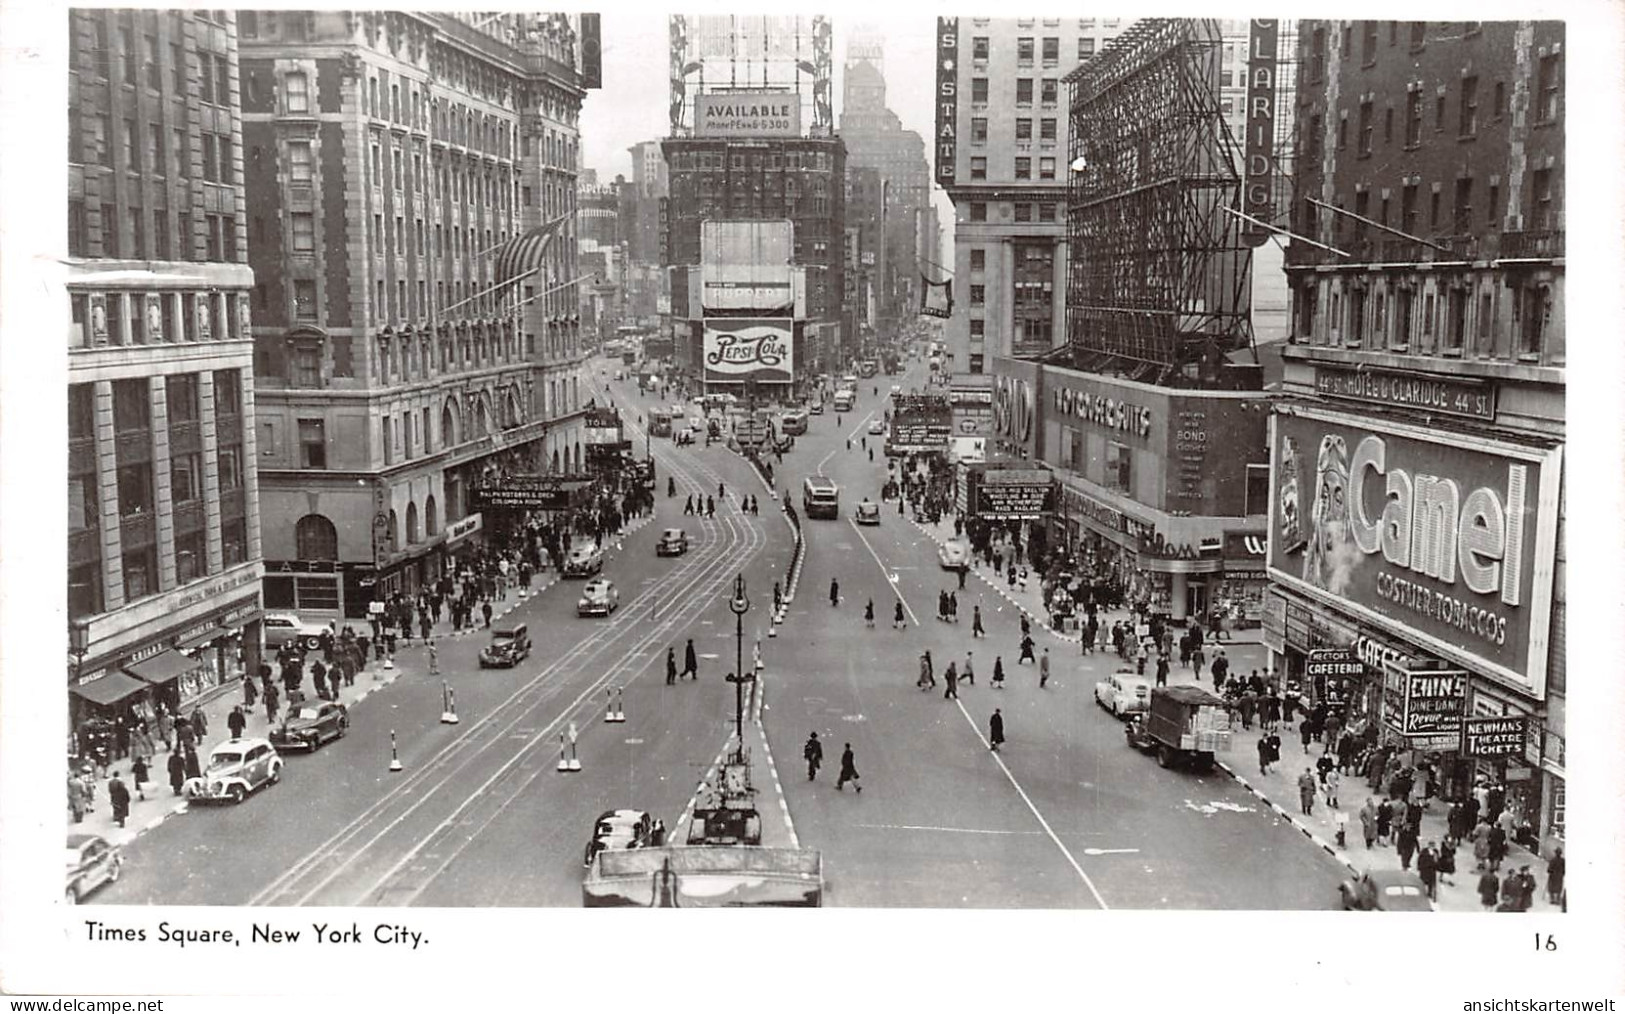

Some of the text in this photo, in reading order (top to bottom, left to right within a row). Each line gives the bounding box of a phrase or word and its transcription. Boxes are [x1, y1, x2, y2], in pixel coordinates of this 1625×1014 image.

[706, 105, 790, 117] AVAILABLE
[941, 82, 955, 177] STATE
[1391, 378, 1448, 407] CLARIDGE
[1454, 394, 1469, 413] 44
[1116, 401, 1150, 436] SUITS
[1177, 430, 1206, 442] BOND
[1349, 435, 1527, 607] Camel
[1435, 592, 1506, 646] TOBACCOS
[1308, 663, 1364, 675] CAFETERIA
[1409, 713, 1442, 731] Revue
